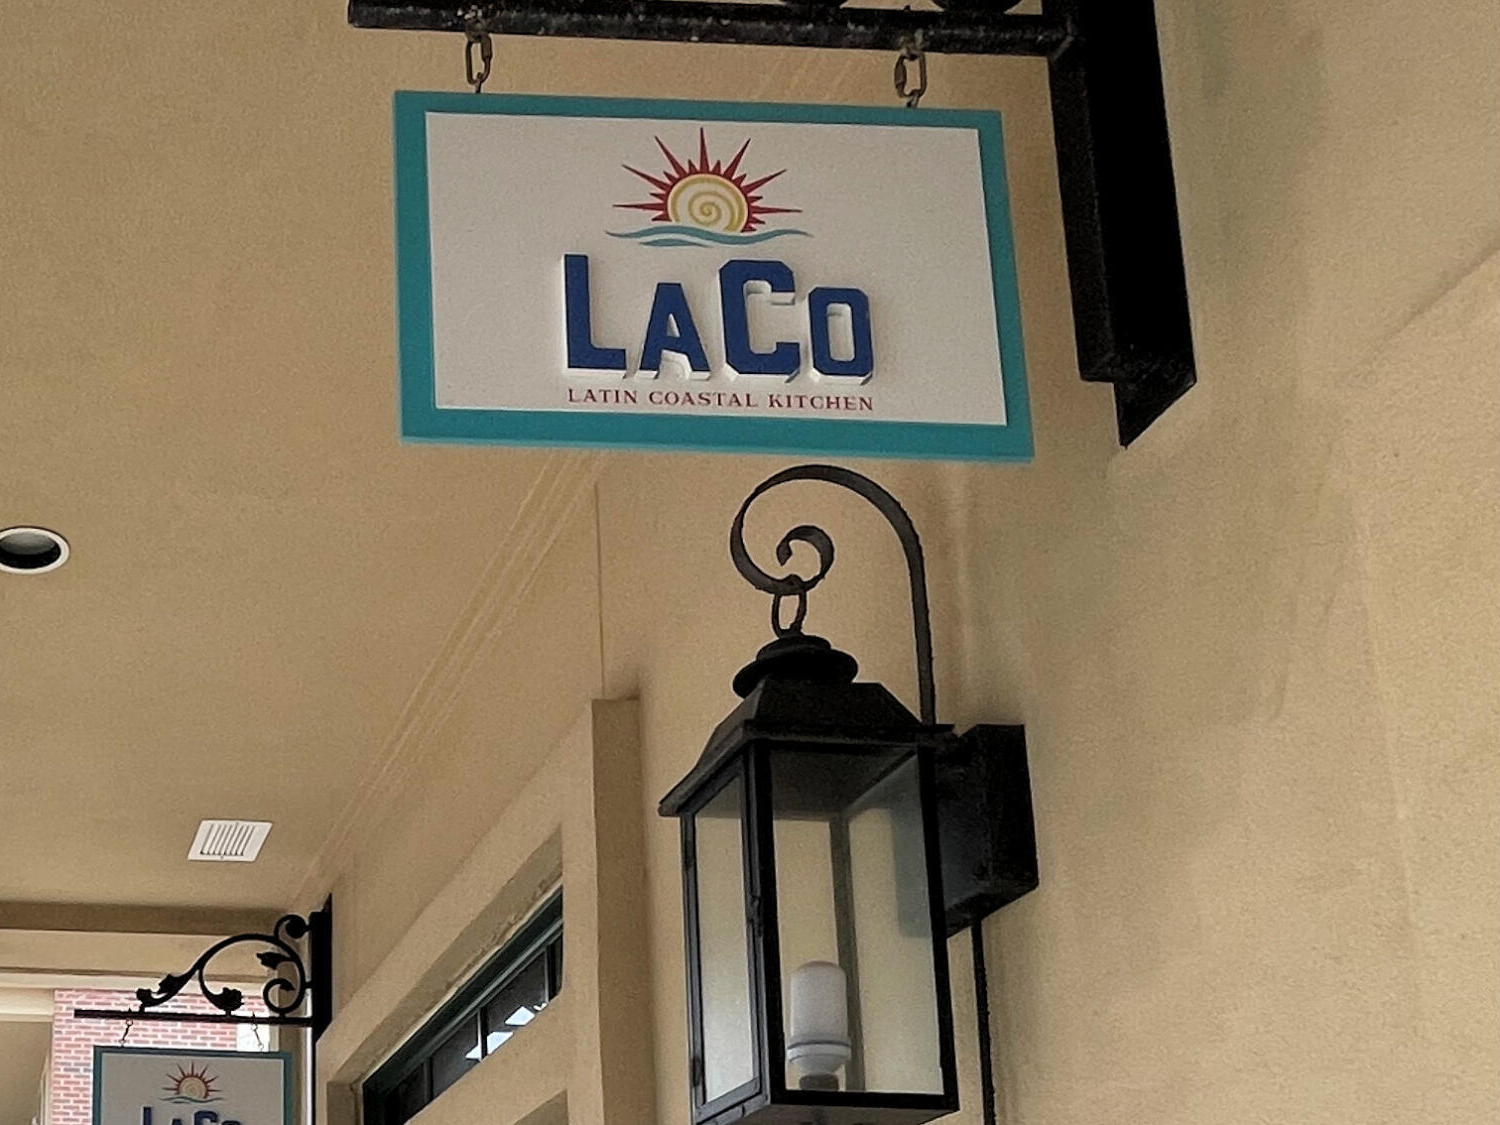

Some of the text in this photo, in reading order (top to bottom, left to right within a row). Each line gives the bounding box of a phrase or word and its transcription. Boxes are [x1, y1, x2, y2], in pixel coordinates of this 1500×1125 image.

[567, 388, 874, 412] LATIN COASTAL KITCHEN
